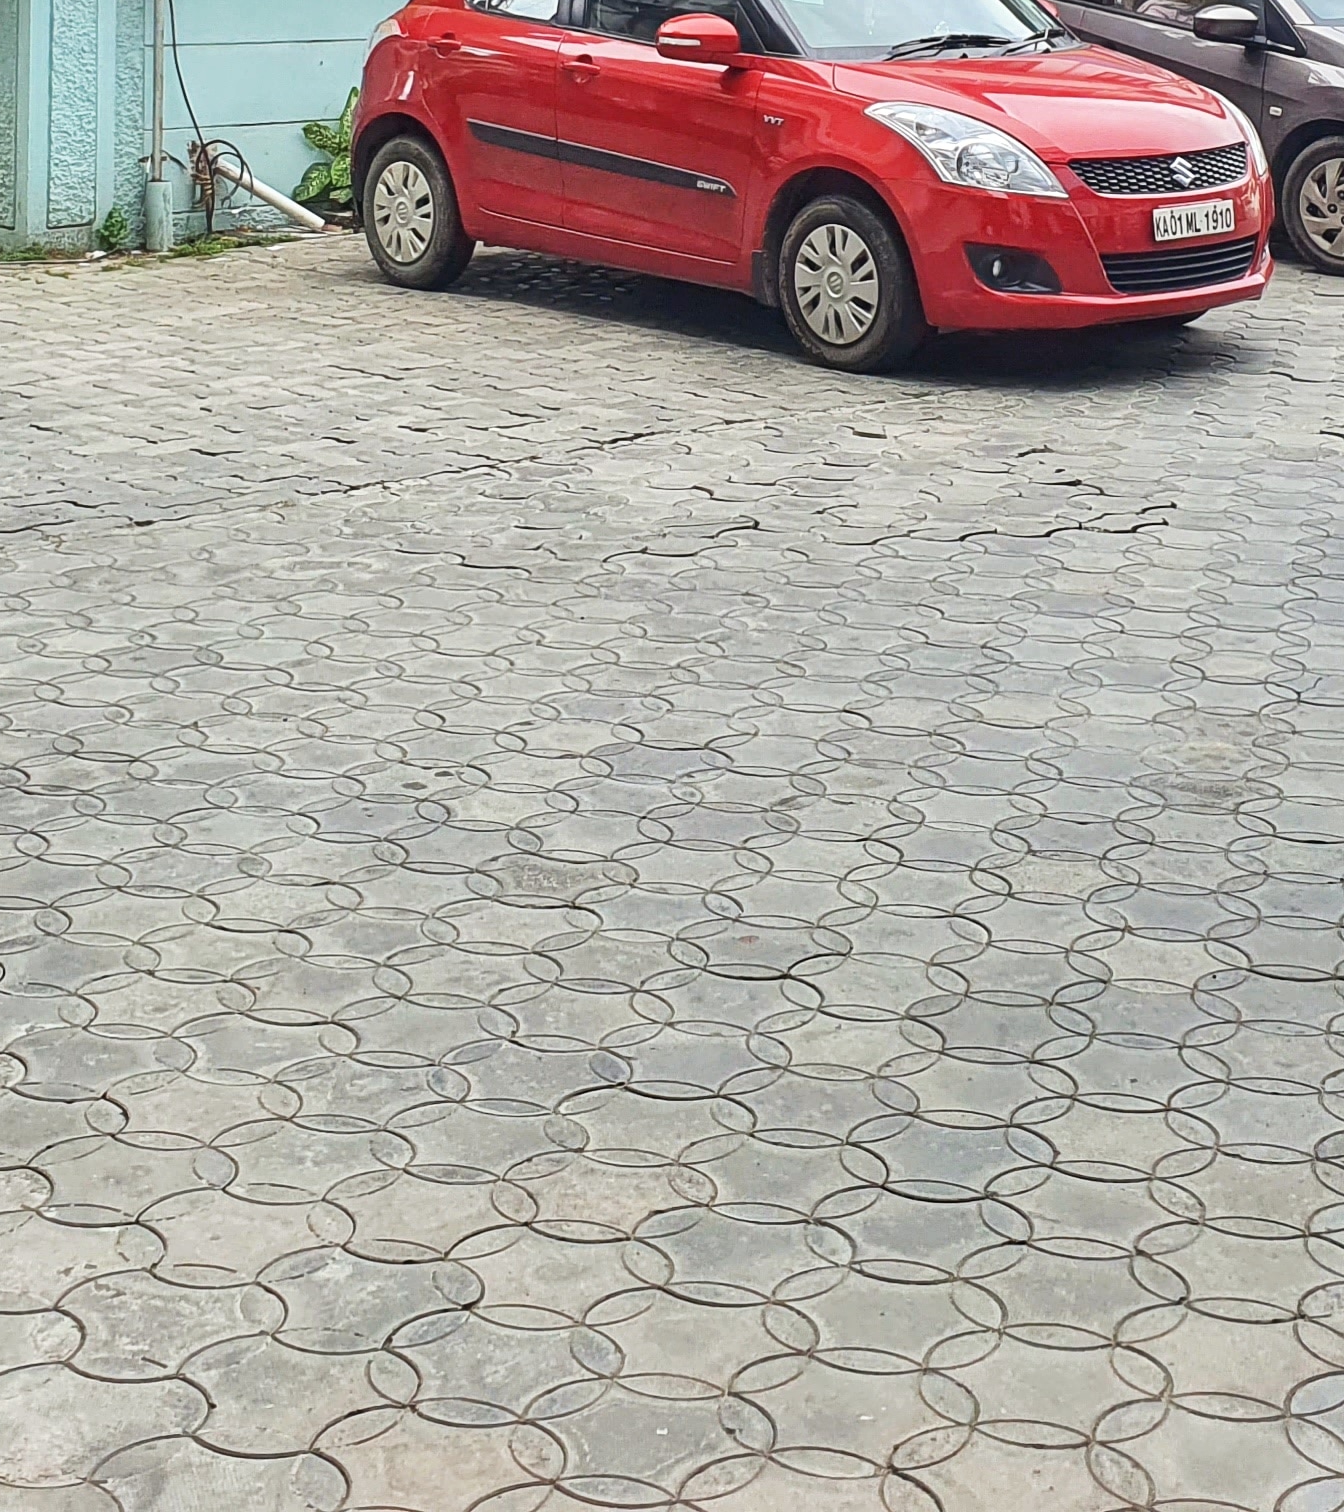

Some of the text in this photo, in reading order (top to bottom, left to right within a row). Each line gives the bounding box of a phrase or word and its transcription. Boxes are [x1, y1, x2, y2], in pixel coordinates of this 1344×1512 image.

[696, 180, 726, 193] SWIFT
[1156, 207, 1232, 238] KA01 ML 1910
